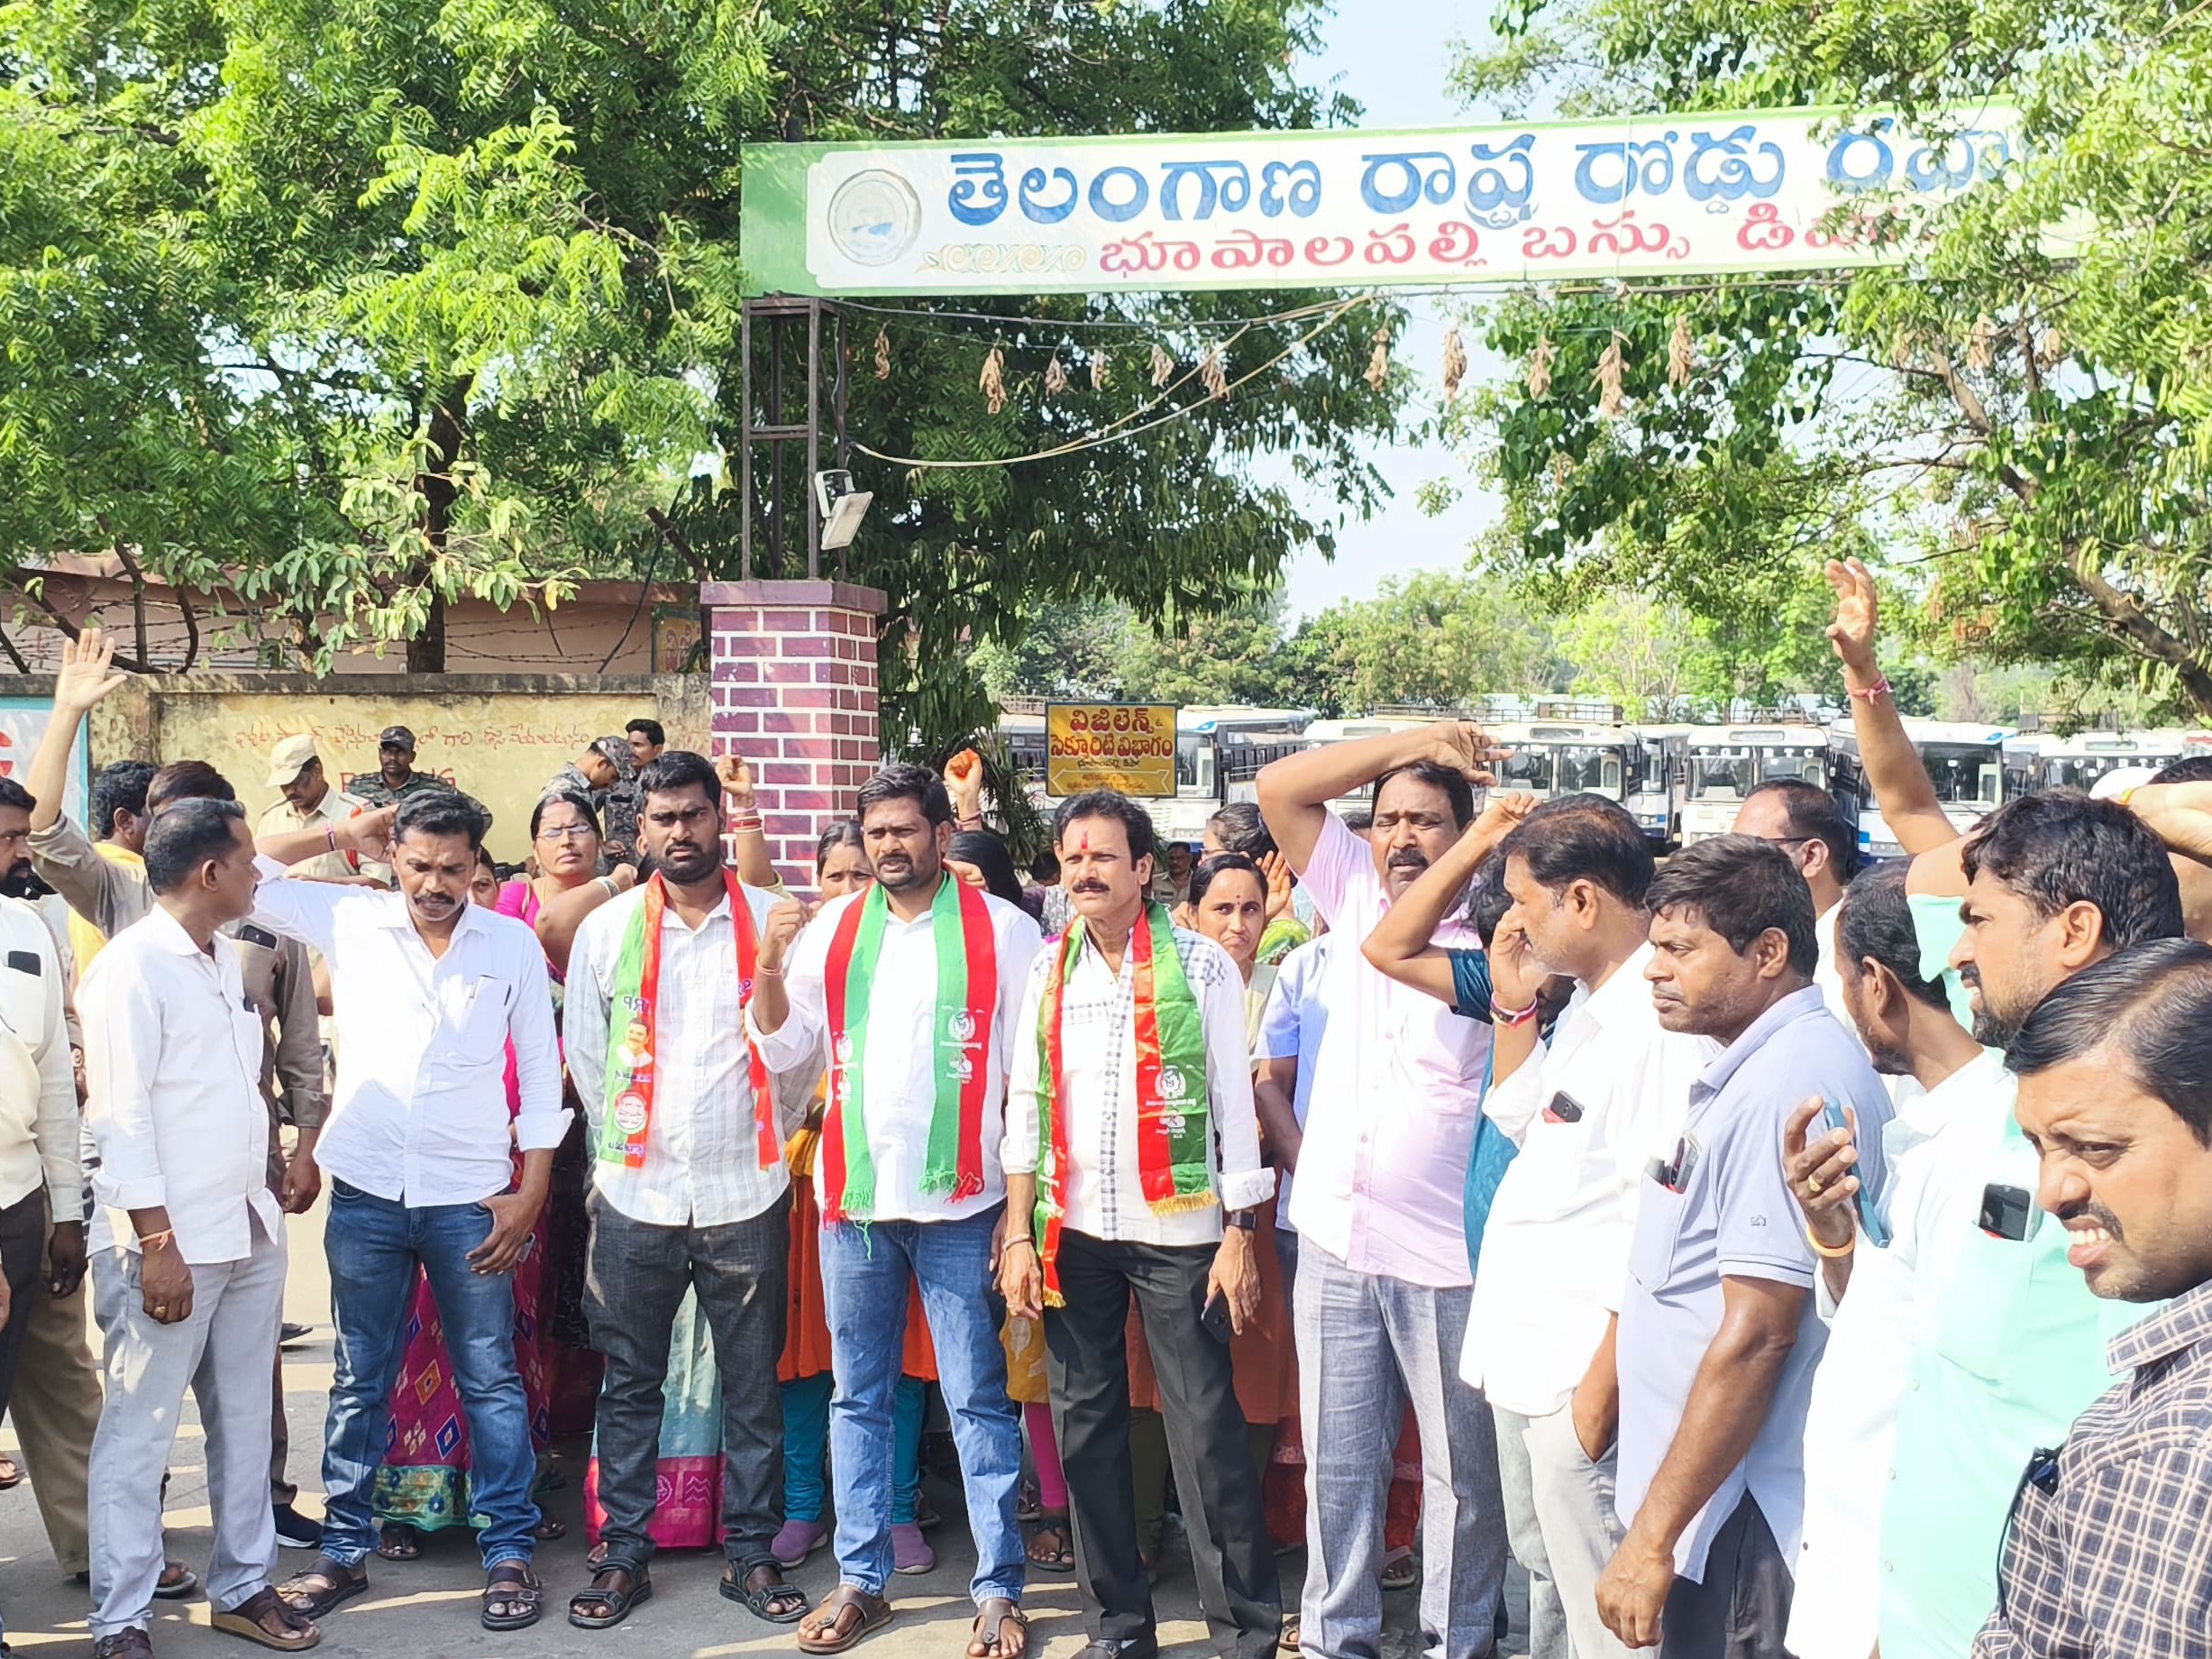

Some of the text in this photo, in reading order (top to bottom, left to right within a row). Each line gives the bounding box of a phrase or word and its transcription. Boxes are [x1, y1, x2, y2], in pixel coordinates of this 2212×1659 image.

[949, 117, 2024, 230] తెలంగాణ రాష్ట్ర రోడ్డు రవా
[1099, 219, 1488, 278] భూపాలపల్లి
[1522, 209, 1691, 260] బస్సు
